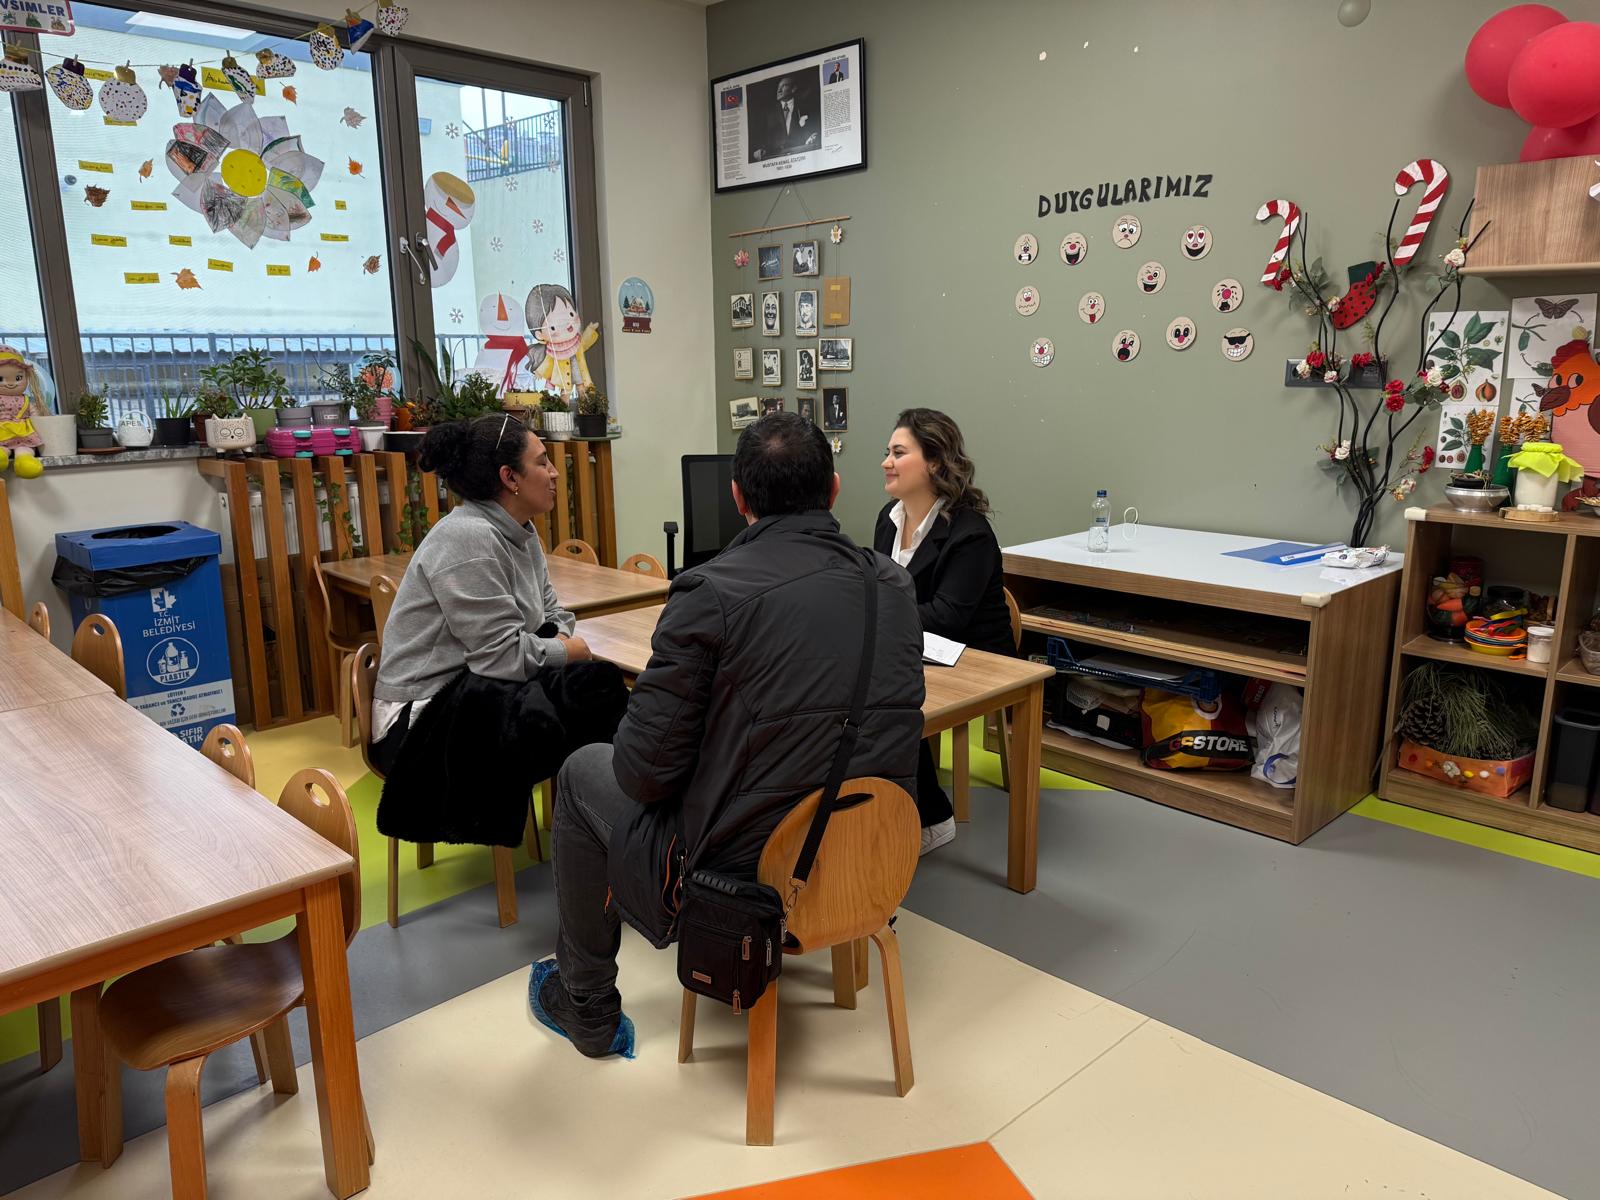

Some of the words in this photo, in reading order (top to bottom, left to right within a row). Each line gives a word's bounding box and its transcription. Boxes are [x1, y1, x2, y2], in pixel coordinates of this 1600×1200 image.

[1037, 174, 1213, 218] DUYGULARIMIZ
[153, 615, 180, 627] İZMİT
[142, 620, 196, 638] BELEDİYESİ
[160, 671, 190, 682] PLASTİK
[179, 726, 203, 738] SIFIR
